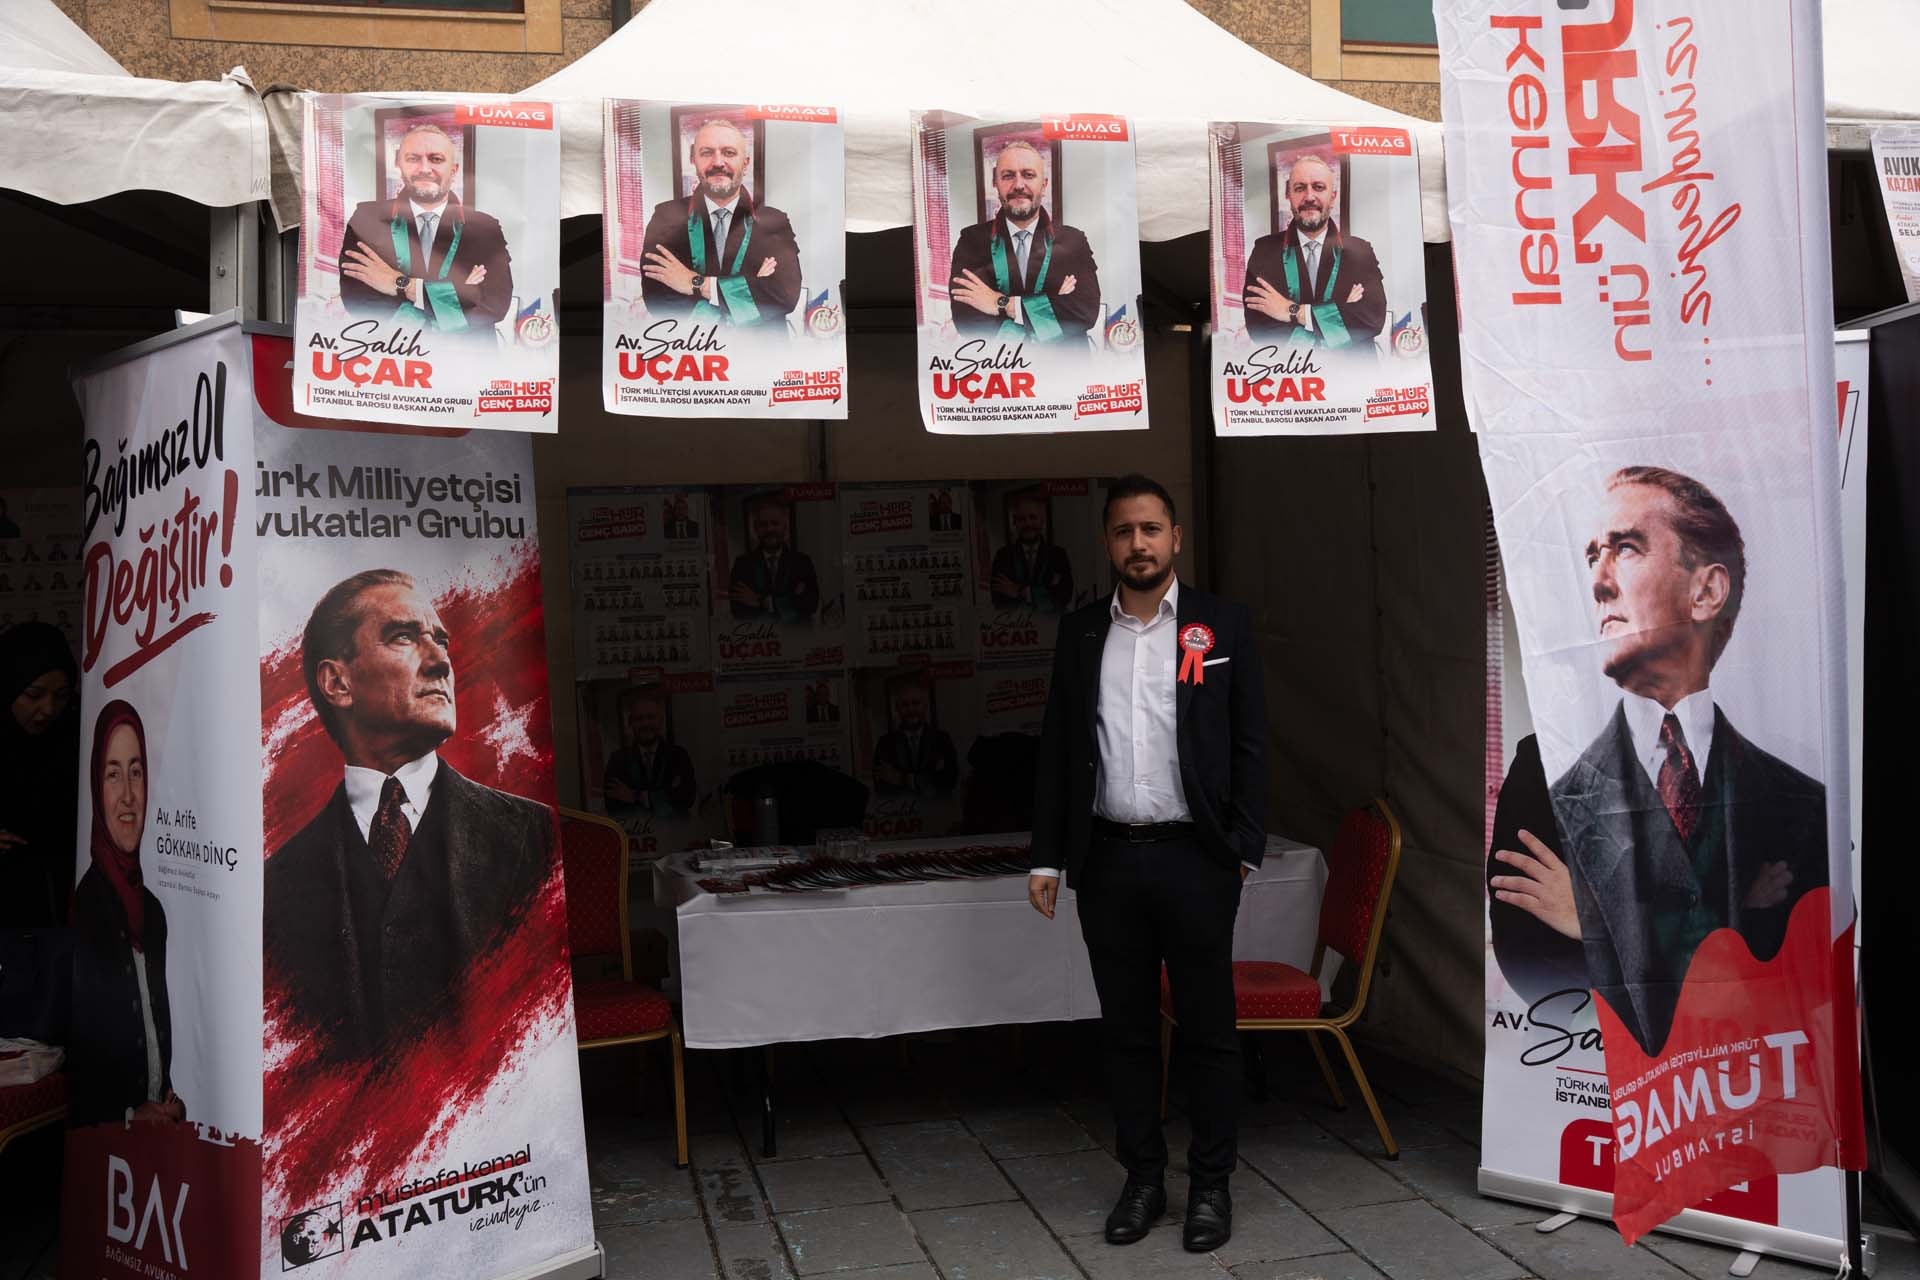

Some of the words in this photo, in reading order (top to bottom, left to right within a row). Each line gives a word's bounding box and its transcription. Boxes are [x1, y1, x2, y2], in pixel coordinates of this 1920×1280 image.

[309, 332, 338, 350] Av.
[336, 320, 430, 362] Salih
[615, 334, 642, 350] Av.
[641, 319, 726, 361] Salih
[618, 352, 730, 385] UÇAR
[929, 356, 954, 370] Av.
[953, 339, 1032, 380] Salih
[1223, 362, 1246, 376] Av.
[1246, 345, 1321, 385] Salih
[312, 352, 432, 388] UÇAR
[804, 371, 840, 384] HÜR
[314, 388, 336, 396] TÜRK
[338, 390, 392, 401] MİLLİYETÇİSİ
[392, 394, 446, 404] AVUKATLAR
[446, 398, 472, 406] GRUBU
[513, 382, 552, 396] HÜR
[621, 386, 641, 394] TÜRK
[643, 388, 691, 397] MİLLİYETÇİSİ
[774, 389, 806, 399] GENÇ
[808, 386, 840, 396] BARO
[933, 372, 1036, 404] UÇAR
[1106, 383, 1141, 398] HÜR
[1226, 377, 1326, 406] UÇAR
[1394, 386, 1427, 400] HÜR
[313, 396, 354, 406] İSTANBUL
[356, 400, 392, 410] BAROSU
[393, 403, 427, 412] BAŞKAN
[428, 406, 455, 414] ADAYI
[481, 400, 514, 410] GENÇ
[516, 398, 550, 408] BARO
[621, 395, 659, 404] İSTANBUL
[694, 398, 725, 406] BAŞKAN
[956, 405, 1000, 414] MİLLİYETÇİSİ
[1080, 402, 1108, 412] GENÇ
[1110, 398, 1140, 408] BARO
[1368, 405, 1396, 415] GENÇ
[1398, 402, 1427, 412] BARO
[936, 414, 970, 422] İSTANBUL
[972, 414, 1001, 422] BAROSU
[1003, 414, 1033, 422] BAŞKAN
[1230, 416, 1264, 424] İSTANBUL
[1294, 416, 1324, 424] BAŞKAN
[1250, 408, 1292, 417] MİLLİYETÇİSİ
[81, 419, 190, 546] Bağımsız
[327, 465, 522, 512] Milliyetçisi
[417, 508, 525, 539] Grubu
[83, 469, 238, 673] Değiştir!
[156, 808, 171, 826] Av.
[174, 810, 196, 830] Arife
[156, 833, 200, 862] GÖKKAYA
[203, 841, 238, 872] DİNÇ
[1492, 1011, 1528, 1032] AV.
[1556, 1076, 1590, 1092] TÜRK
[358, 1168, 460, 1213] mustafa
[464, 1144, 532, 1181] kemal
[105, 1244, 142, 1272] BAĞIMSIZ
[144, 1264, 177, 1280] AVUKAT
